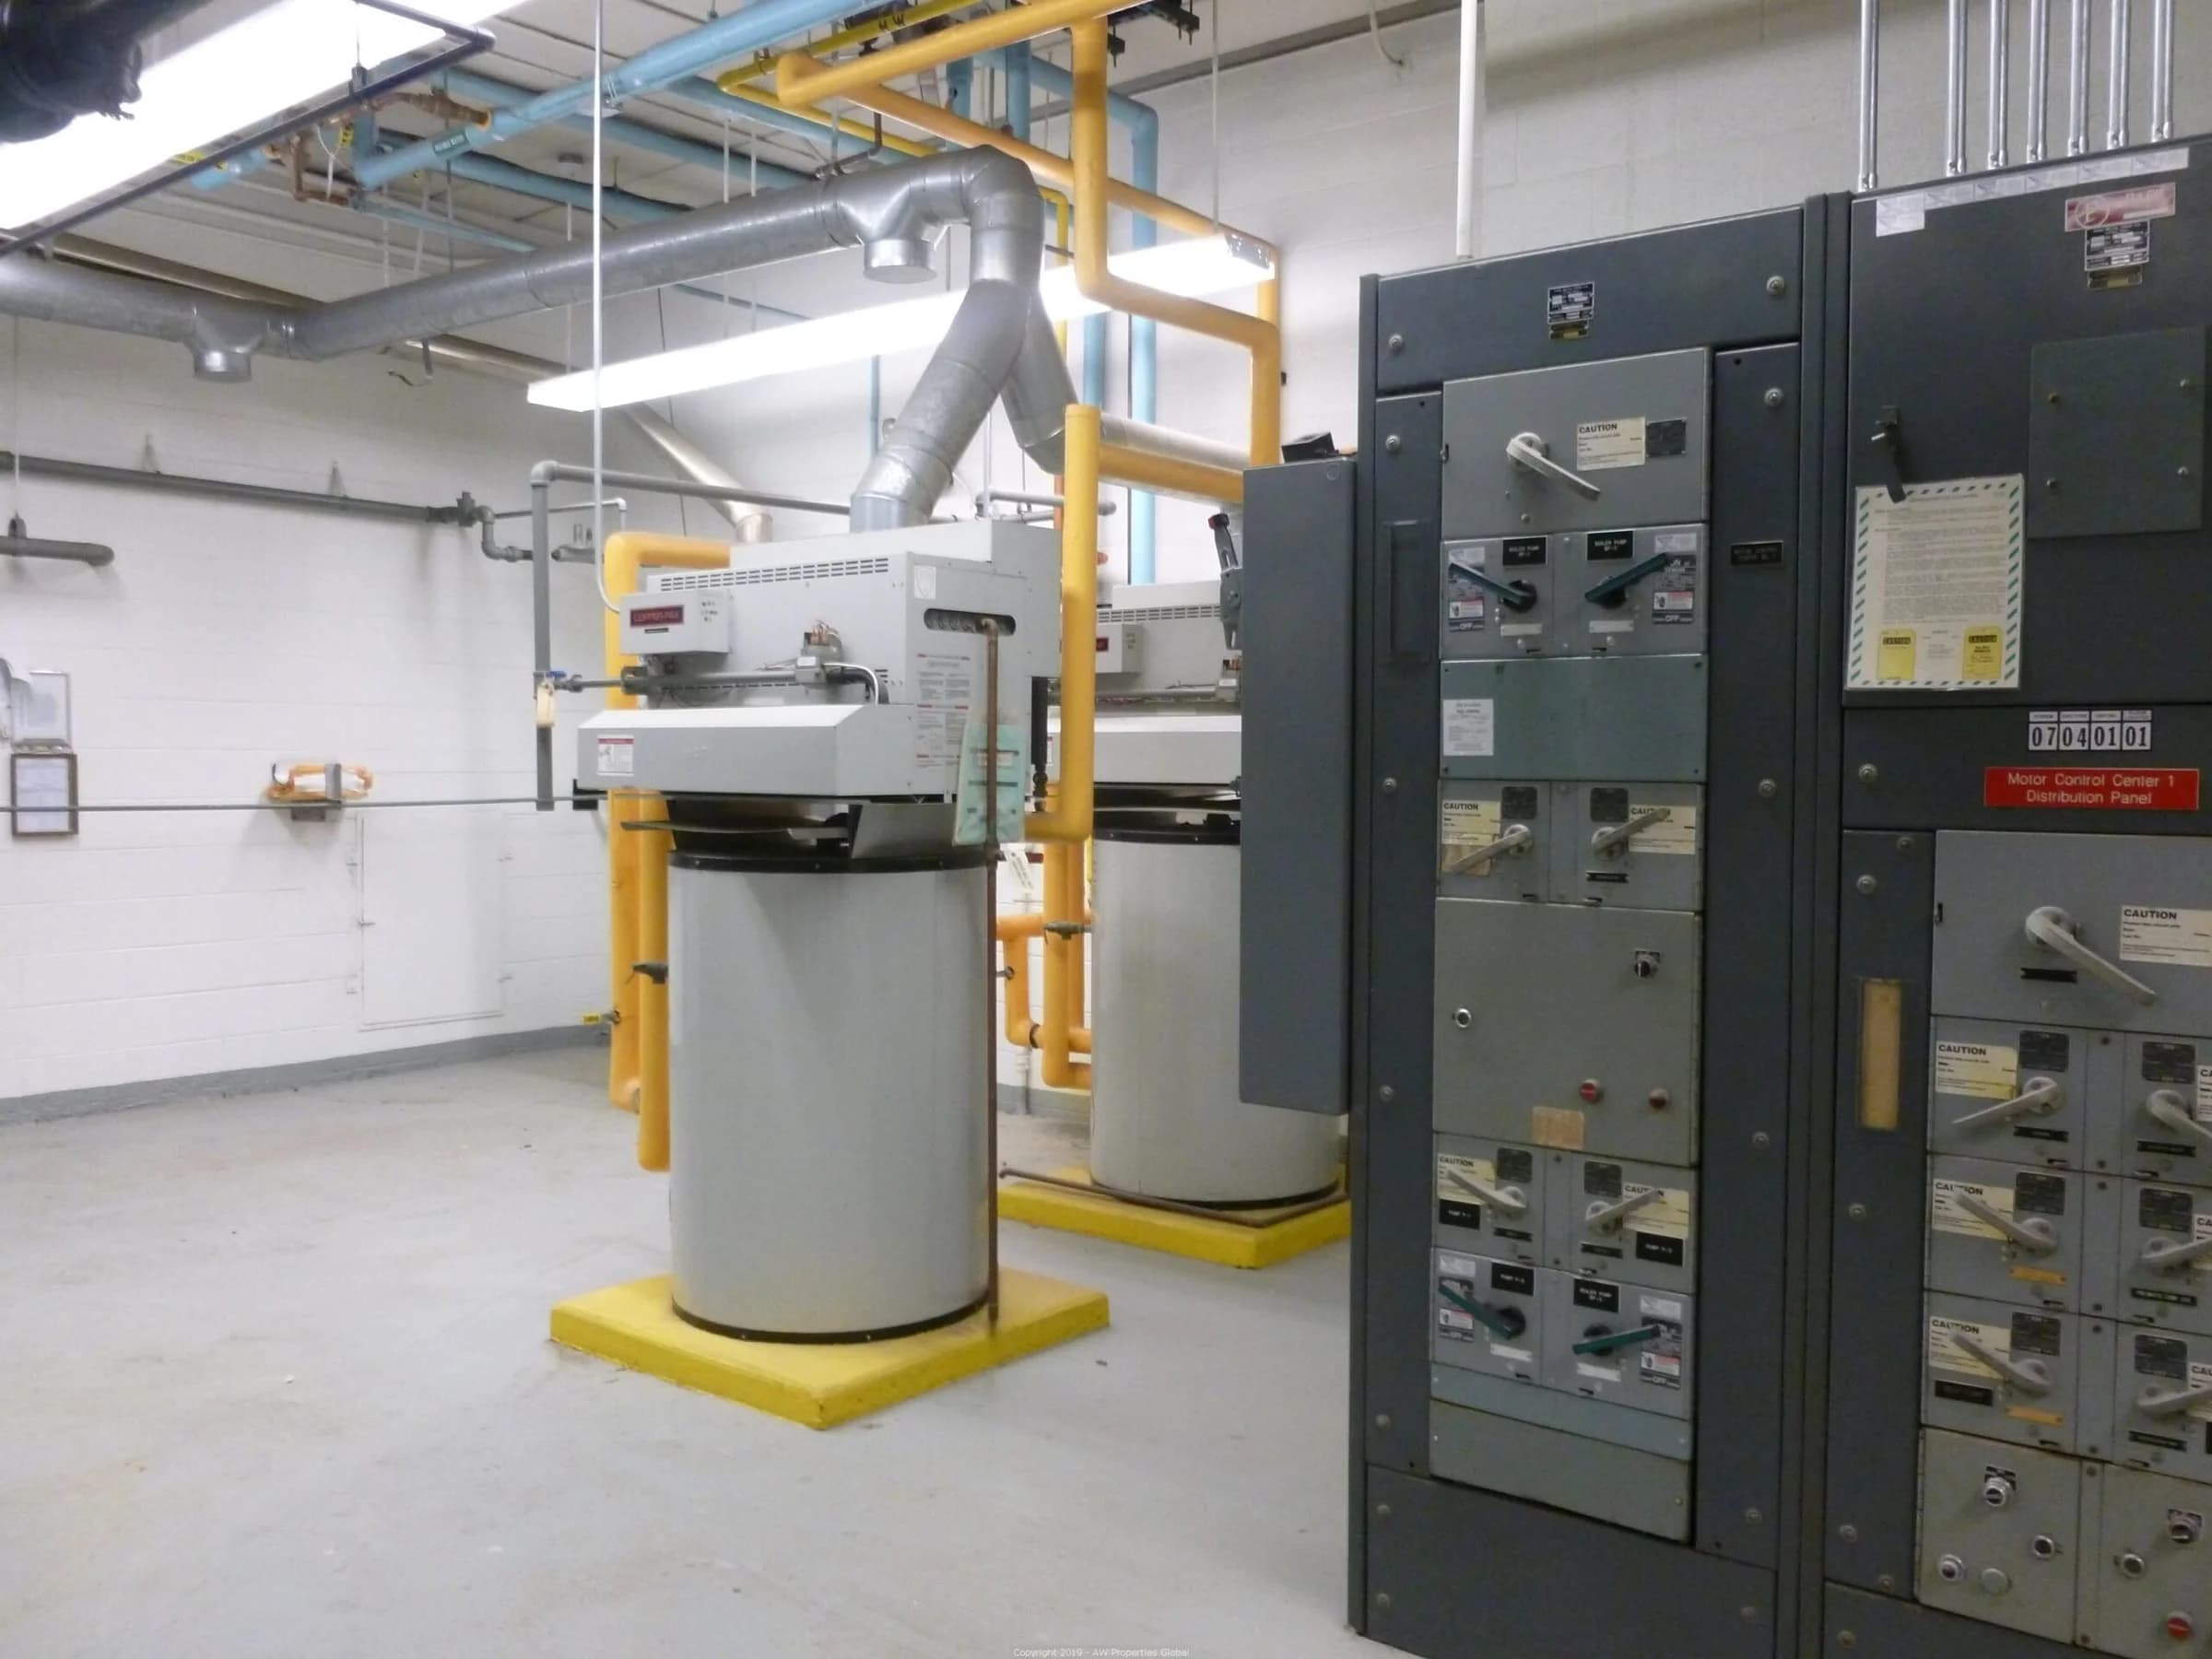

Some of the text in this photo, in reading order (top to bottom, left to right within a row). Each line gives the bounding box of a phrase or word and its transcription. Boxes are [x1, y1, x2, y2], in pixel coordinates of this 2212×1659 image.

[1579, 424, 1618, 434] CAUTION
[2008, 772, 2175, 787] Motor Control Center 1
[2027, 790, 2152, 804] Distribution Panel
[2124, 909, 2177, 920] CAUTION
[1938, 1044, 1987, 1055] CAUTION
[1439, 1156, 1474, 1167] CAUTION
